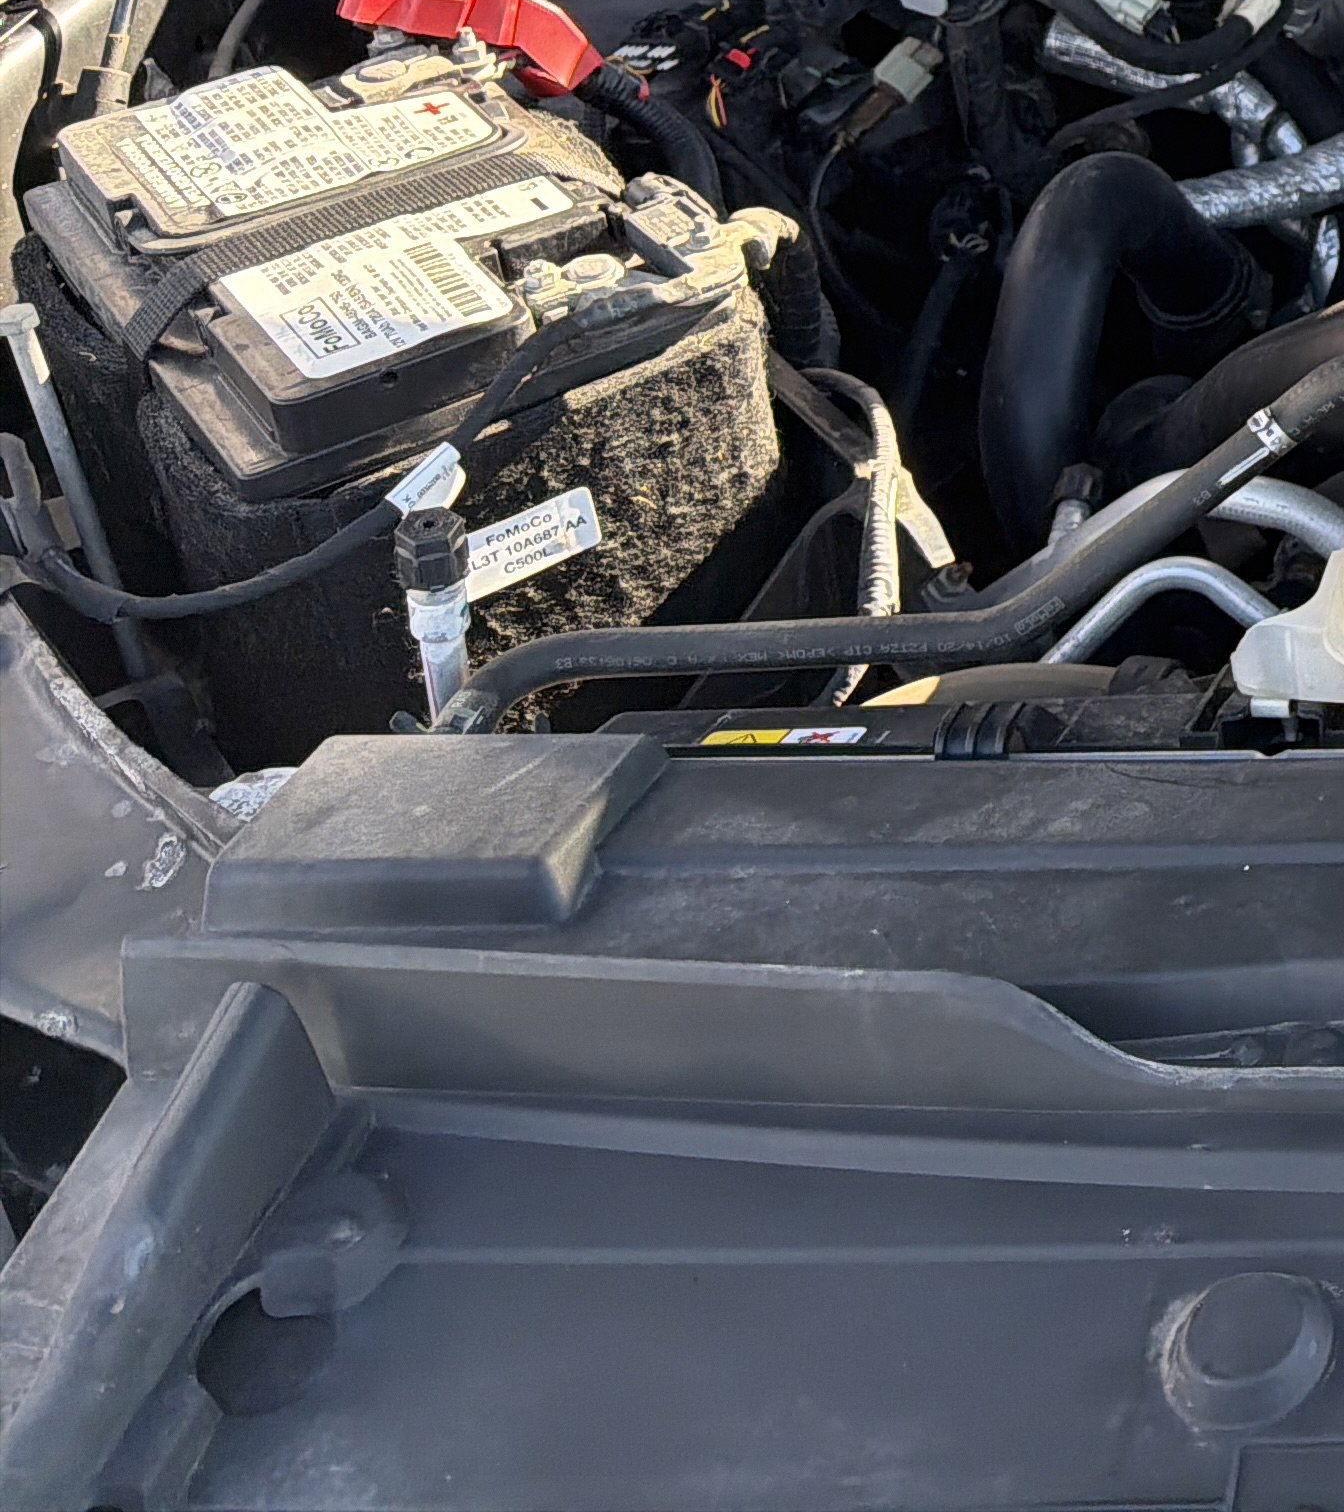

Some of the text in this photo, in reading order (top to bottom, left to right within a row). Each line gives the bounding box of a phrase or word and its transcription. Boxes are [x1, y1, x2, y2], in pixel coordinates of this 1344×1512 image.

[298, 304, 350, 354] FoMoCo
[471, 514, 587, 571] L3T 10A687 AA
[485, 513, 552, 547] FoMoCo
[503, 547, 553, 574] C500L
